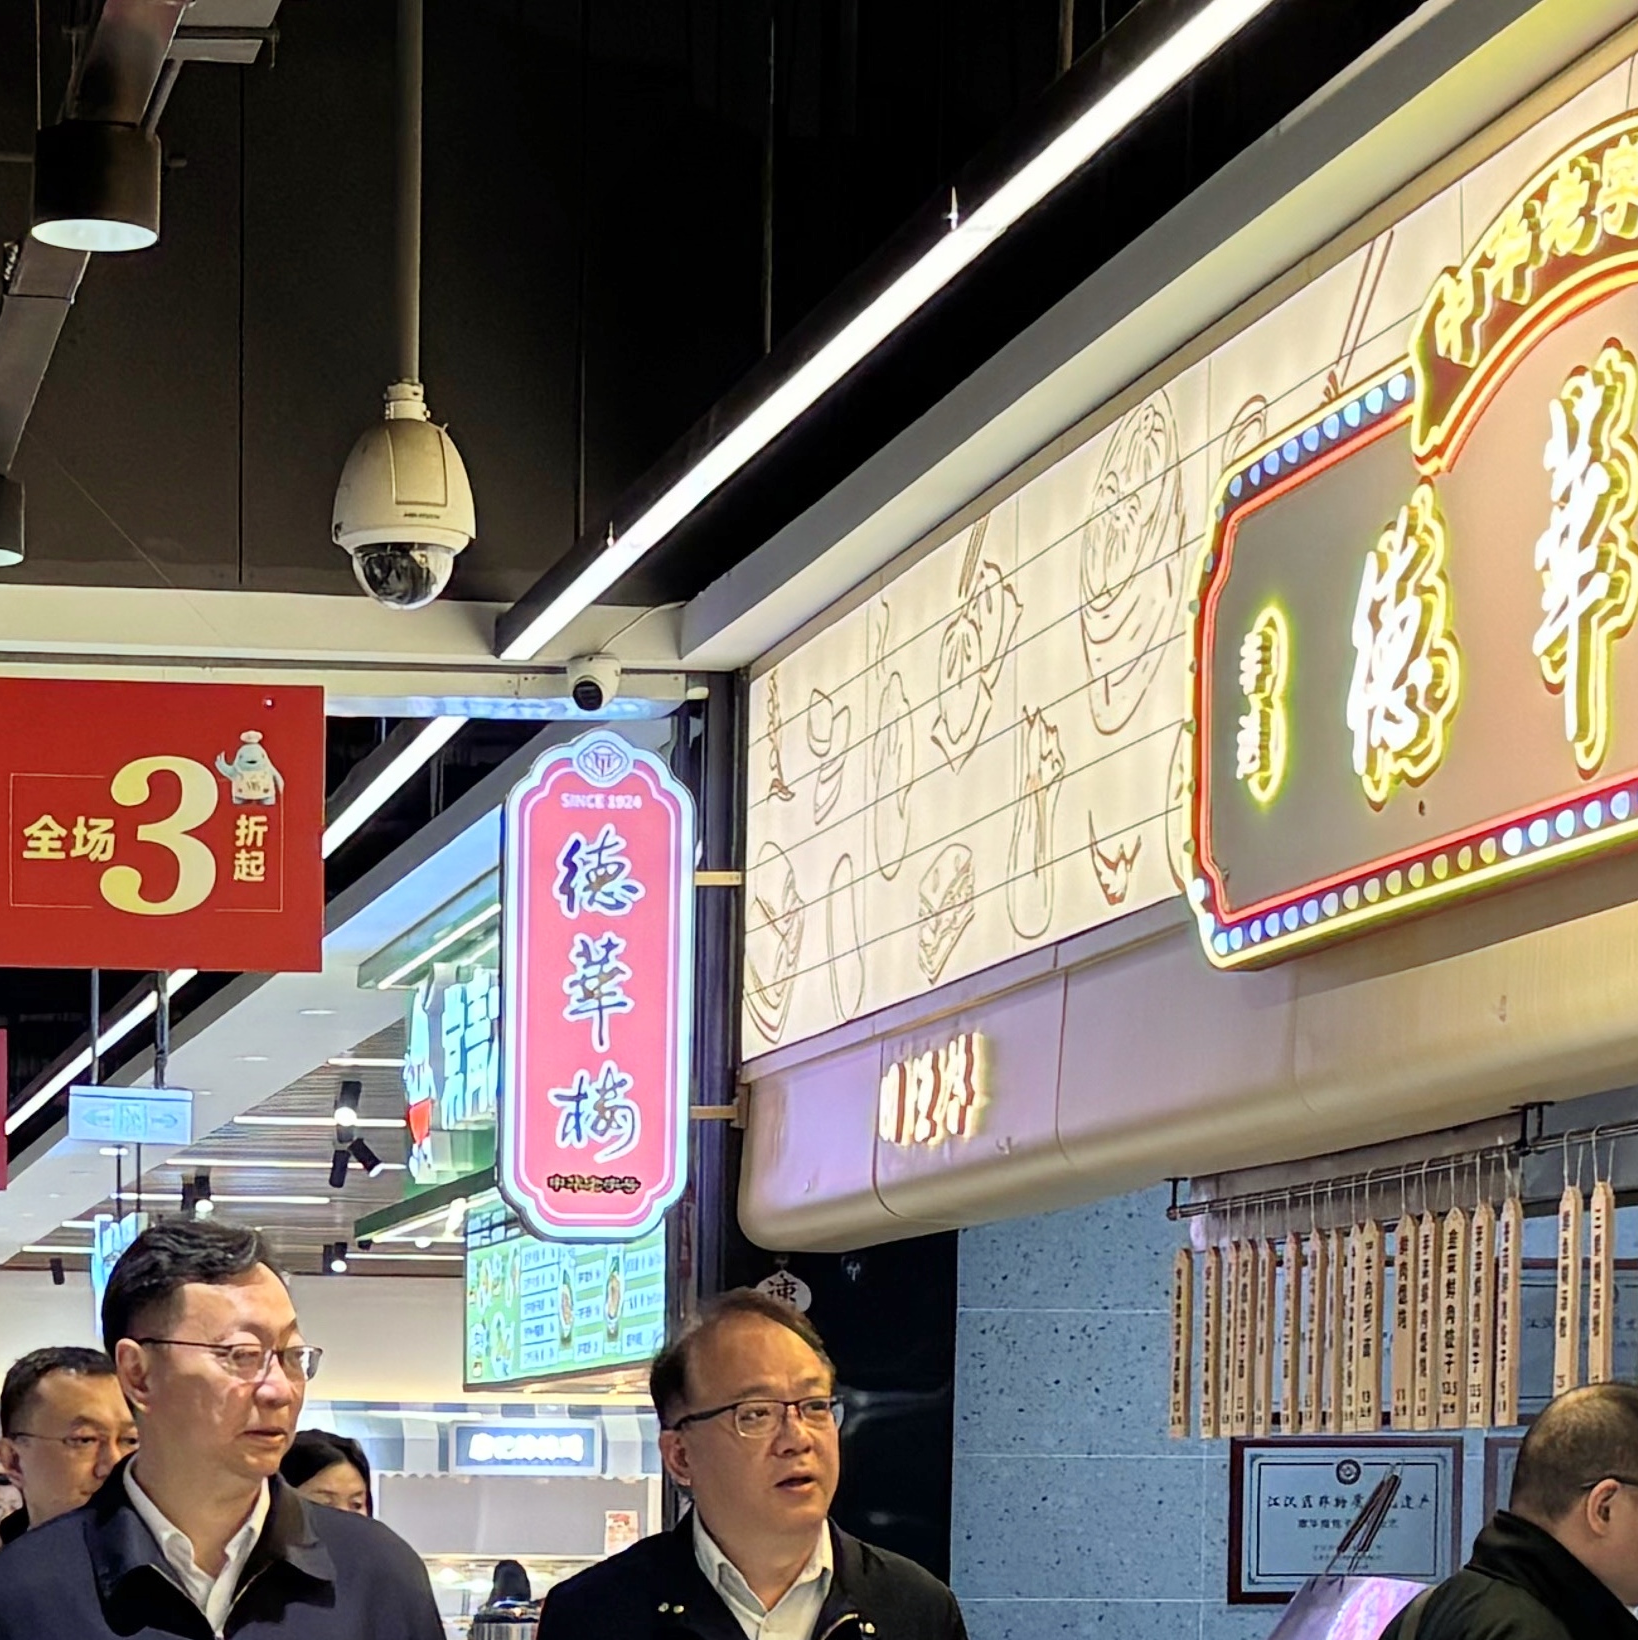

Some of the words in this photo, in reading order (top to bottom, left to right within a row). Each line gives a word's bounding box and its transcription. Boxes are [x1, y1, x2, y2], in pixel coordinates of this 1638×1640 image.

[560, 793, 604, 809] SINCE
[608, 794, 643, 810] 1924
[23, 815, 116, 863] 全场
[99, 755, 219, 915] 3
[233, 813, 269, 882] 折起
[547, 1173, 642, 1195] 中华老字号
[1268, 1492, 1430, 1510] 江汉区非物质遗产
